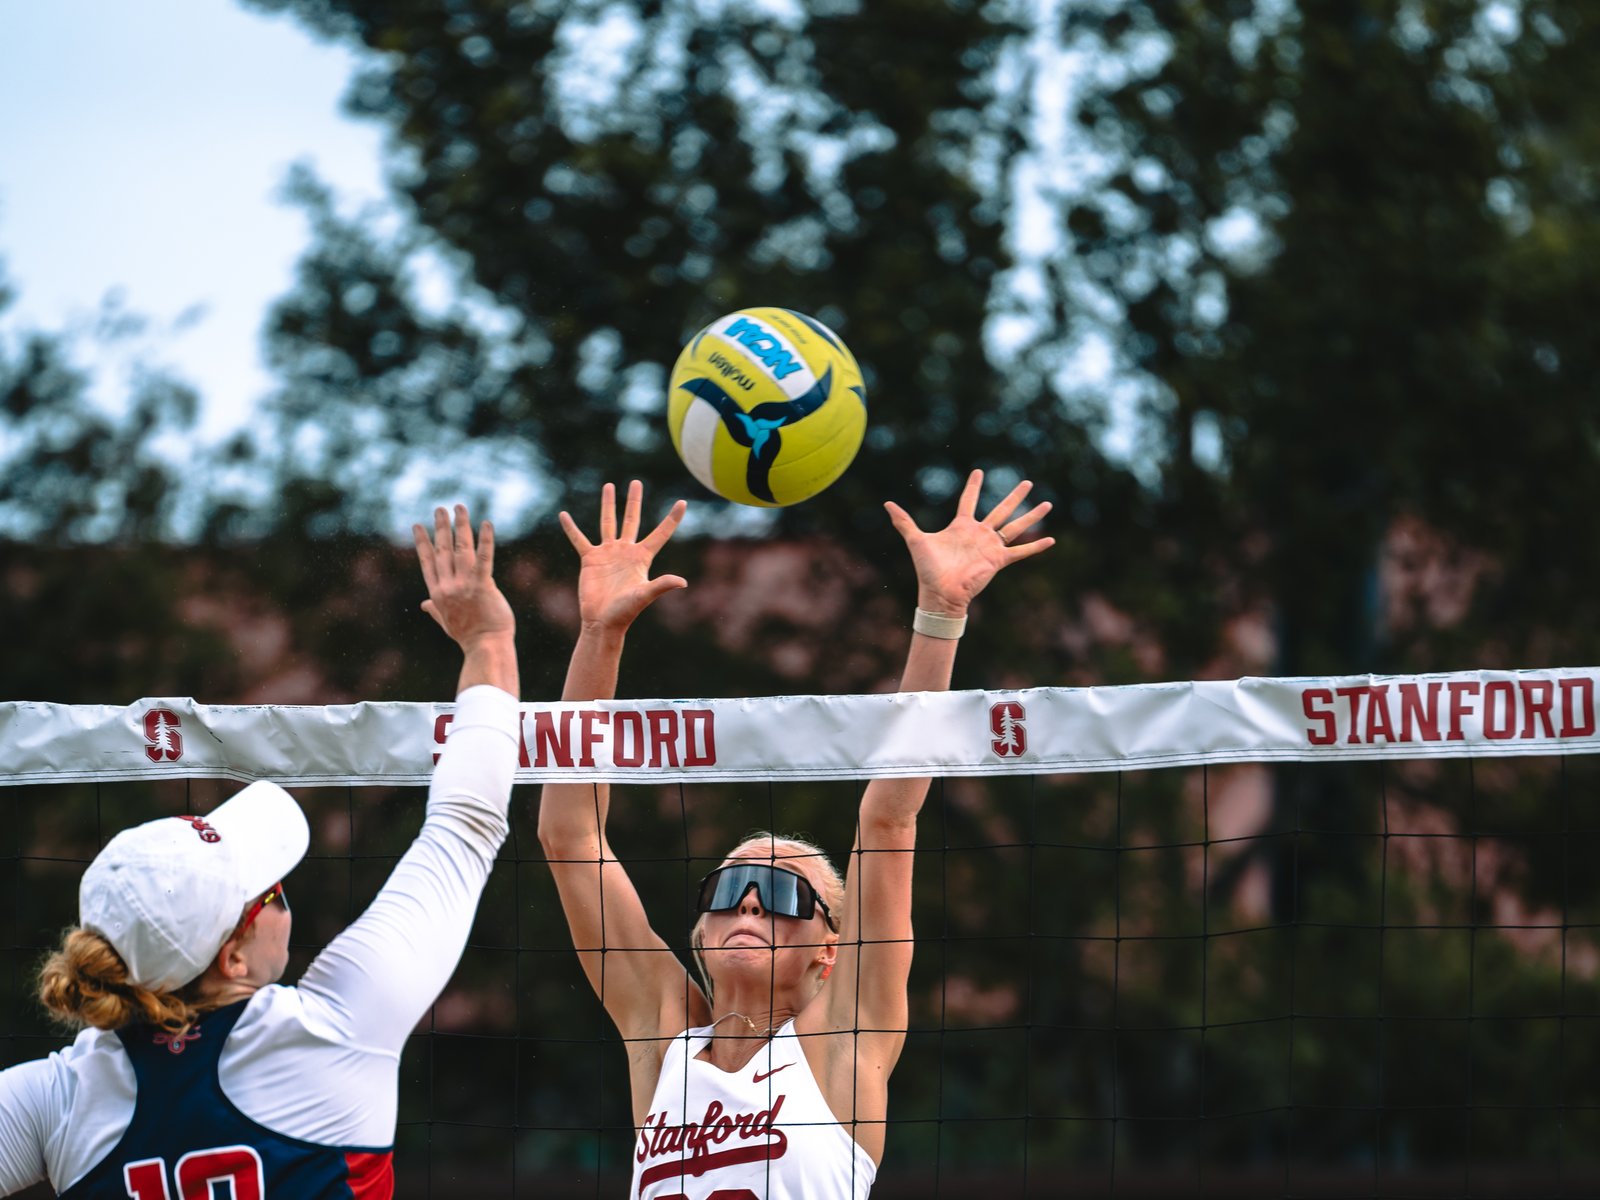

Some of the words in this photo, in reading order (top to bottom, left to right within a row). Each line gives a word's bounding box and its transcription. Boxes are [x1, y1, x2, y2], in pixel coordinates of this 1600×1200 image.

[707, 351, 757, 391] molten
[724, 317, 804, 381] NCAA
[1301, 677, 1596, 746] STANFORD
[636, 1094, 788, 1178] Stanford
